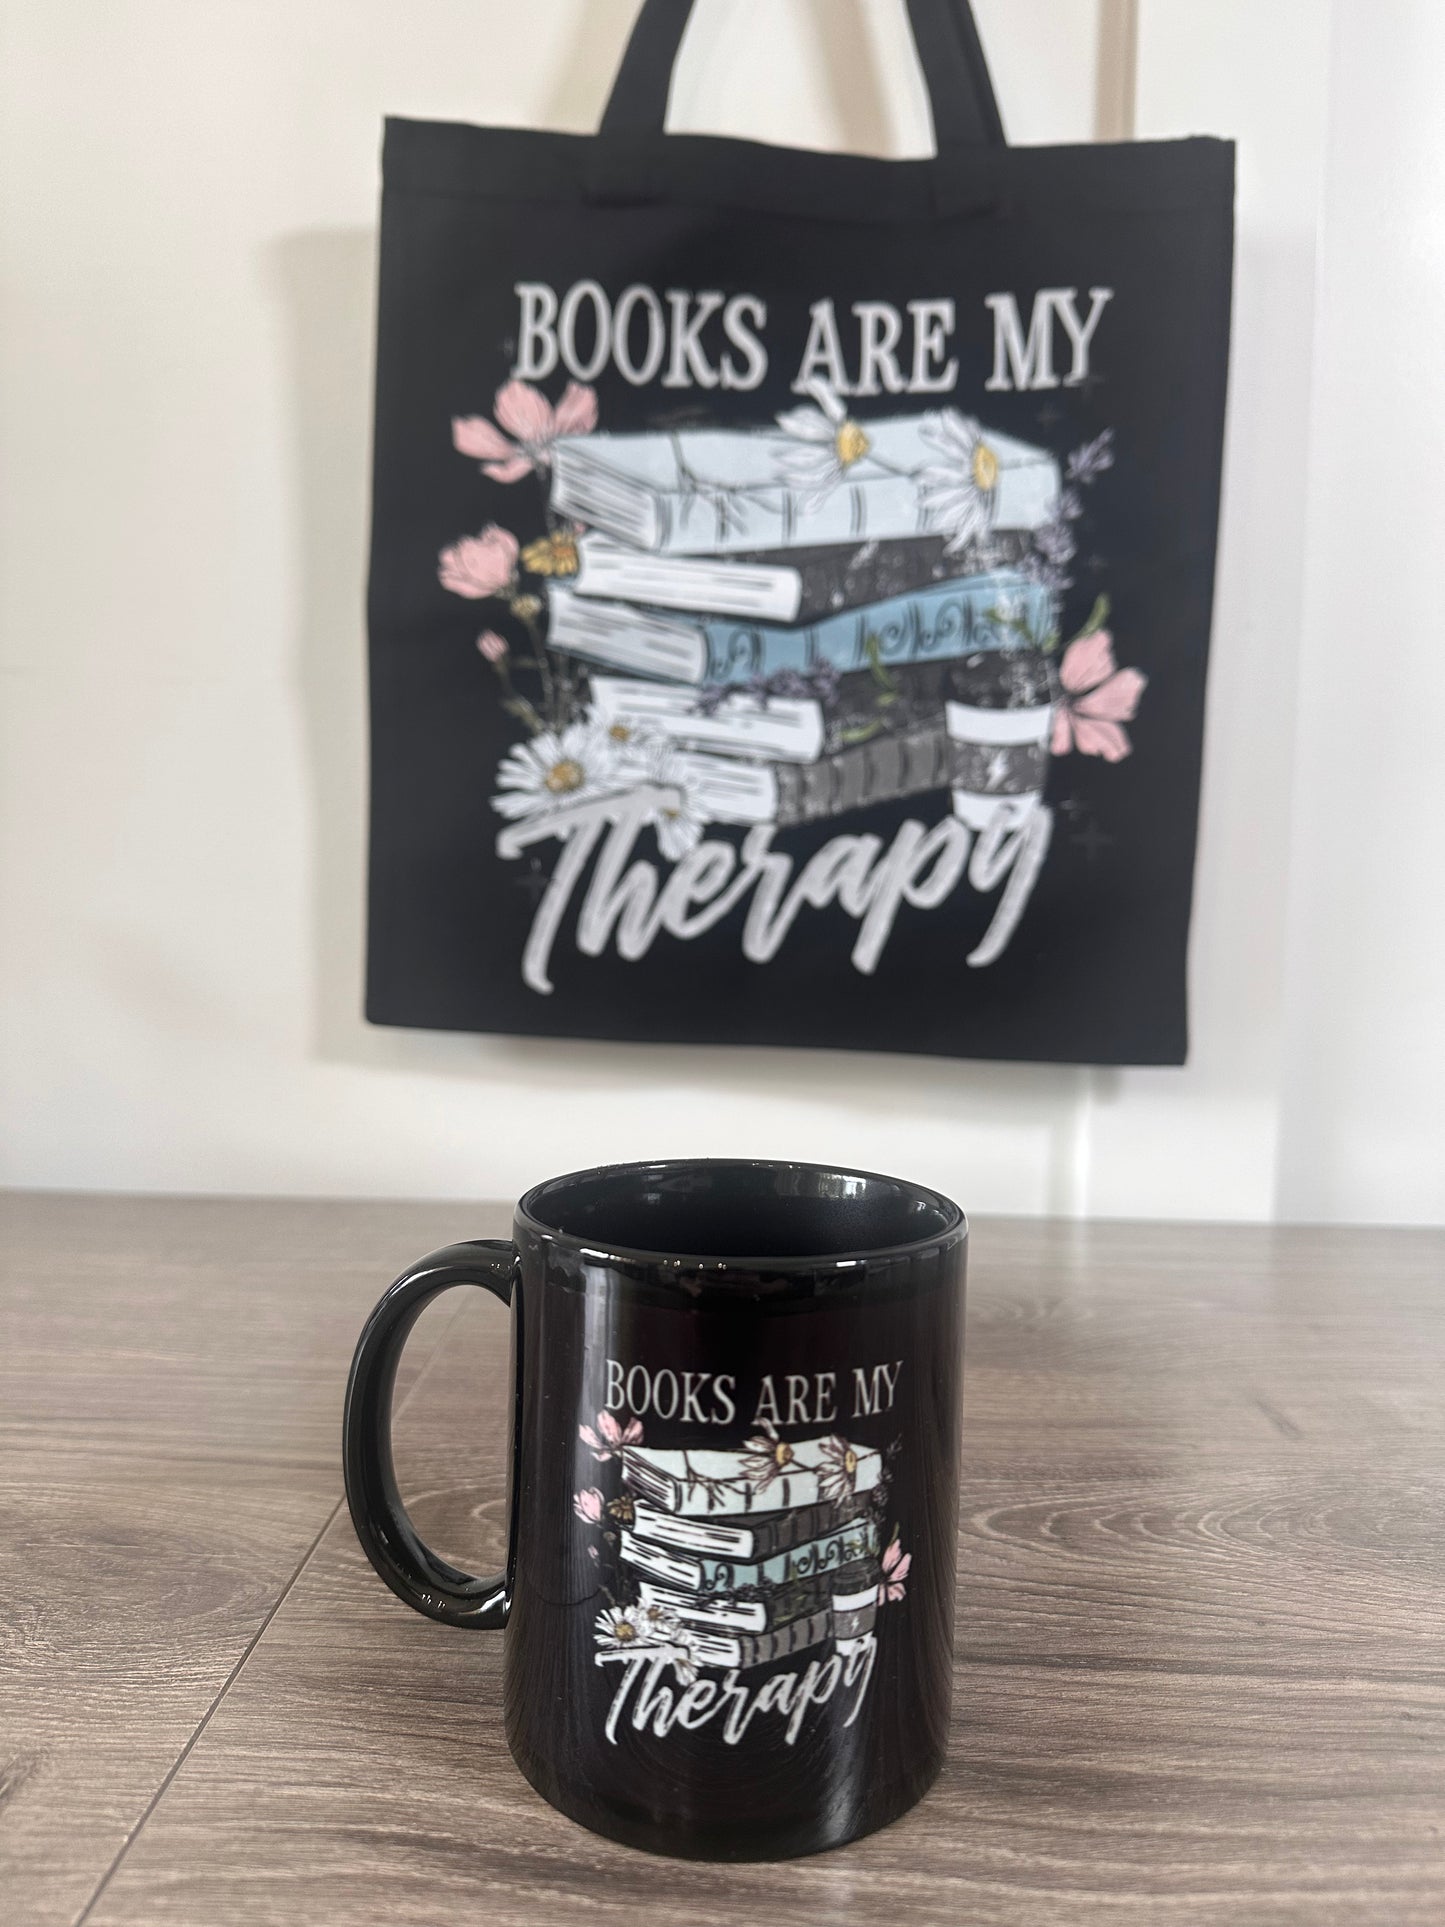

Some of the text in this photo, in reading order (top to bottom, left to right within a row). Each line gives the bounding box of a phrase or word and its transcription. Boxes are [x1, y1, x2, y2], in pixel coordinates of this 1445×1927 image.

[513, 280, 1114, 396] BOOKS ARE MY
[496, 782, 1054, 995] Therapy
[605, 1359, 903, 1426] BOOKS ARE MY
[594, 1637, 878, 1745] Therapy
